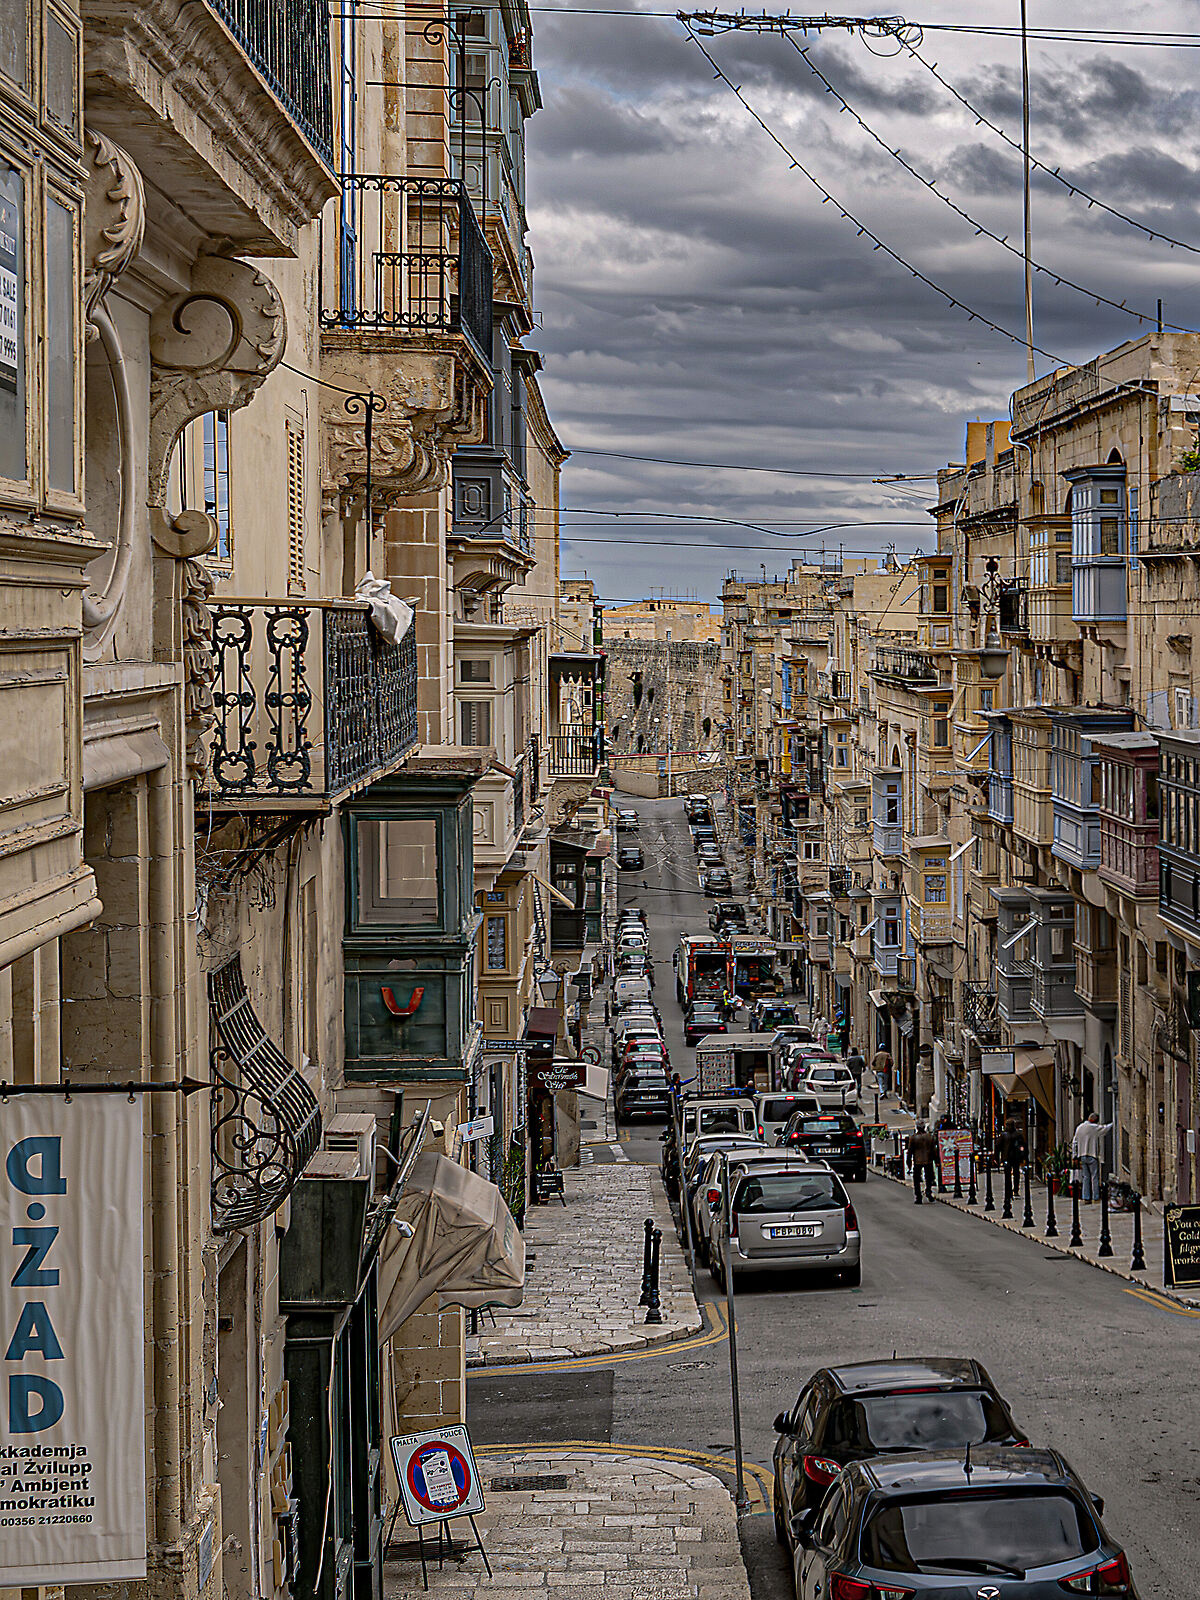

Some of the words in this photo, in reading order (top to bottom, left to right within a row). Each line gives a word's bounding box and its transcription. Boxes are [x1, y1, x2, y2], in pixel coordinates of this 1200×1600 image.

[3, 276, 16, 303] SALE
[553, 1066, 569, 1074] The
[1179, 1230, 1200, 1241] Gold
[396, 1437, 419, 1447] MALTA
[439, 1429, 463, 1439] POLICE
[23, 1458, 93, 1477] Żvilupp
[10, 1477, 90, 1495] Ambjent
[1, 1516, 36, 1527] 00356
